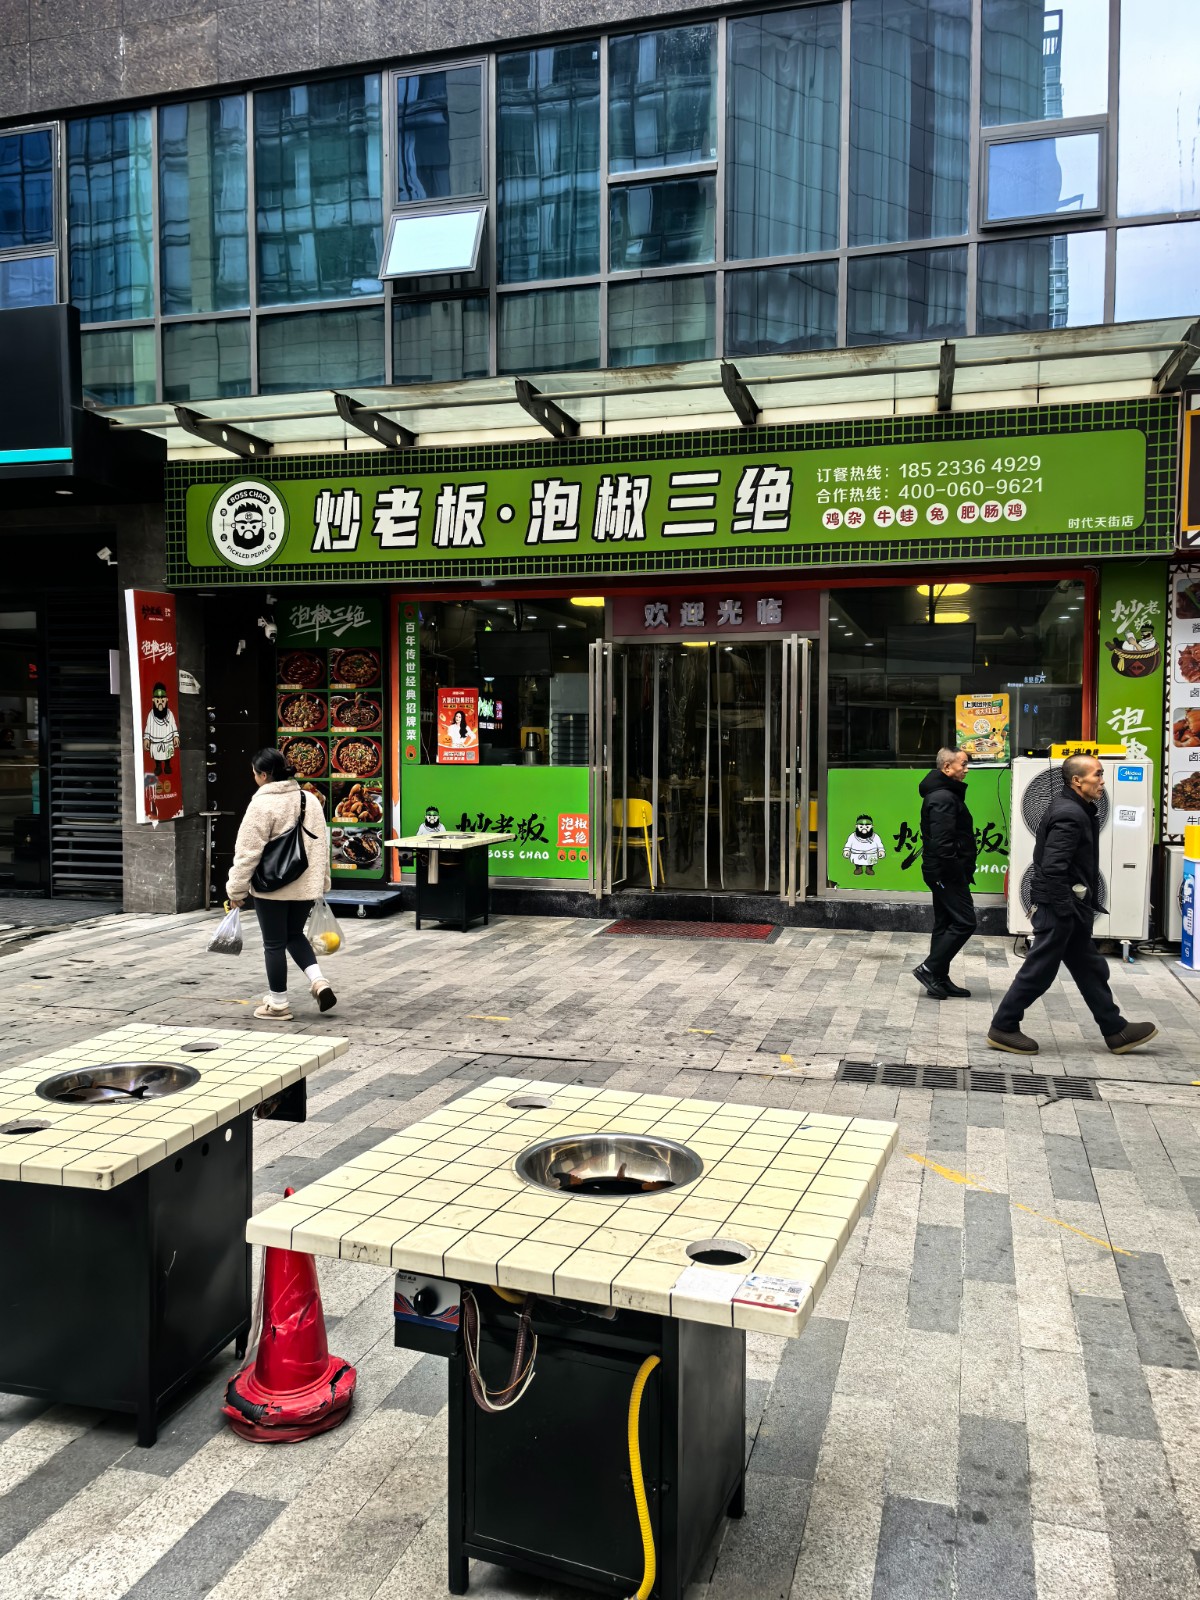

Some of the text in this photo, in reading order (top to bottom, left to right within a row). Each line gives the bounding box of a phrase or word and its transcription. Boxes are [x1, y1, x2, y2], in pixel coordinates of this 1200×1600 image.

[899, 462, 931, 478] 185
[937, 459, 985, 477] 2336
[991, 455, 1041, 473] 4929
[229, 490, 268, 503] BOSS CHAO
[898, 477, 1043, 500] 400-060-9621
[312, 466, 792, 551] 炒老板·泡椒三绝
[960, 503, 1023, 520] 肥肠鸡
[1068, 515, 1134, 529] 时代天街店
[227, 544, 272, 559] PICKLED PEPPER
[644, 598, 782, 627] 欢迎光临
[406, 622, 417, 741] 百年传世经典招牌菜
[520, 850, 549, 860] CHAO
